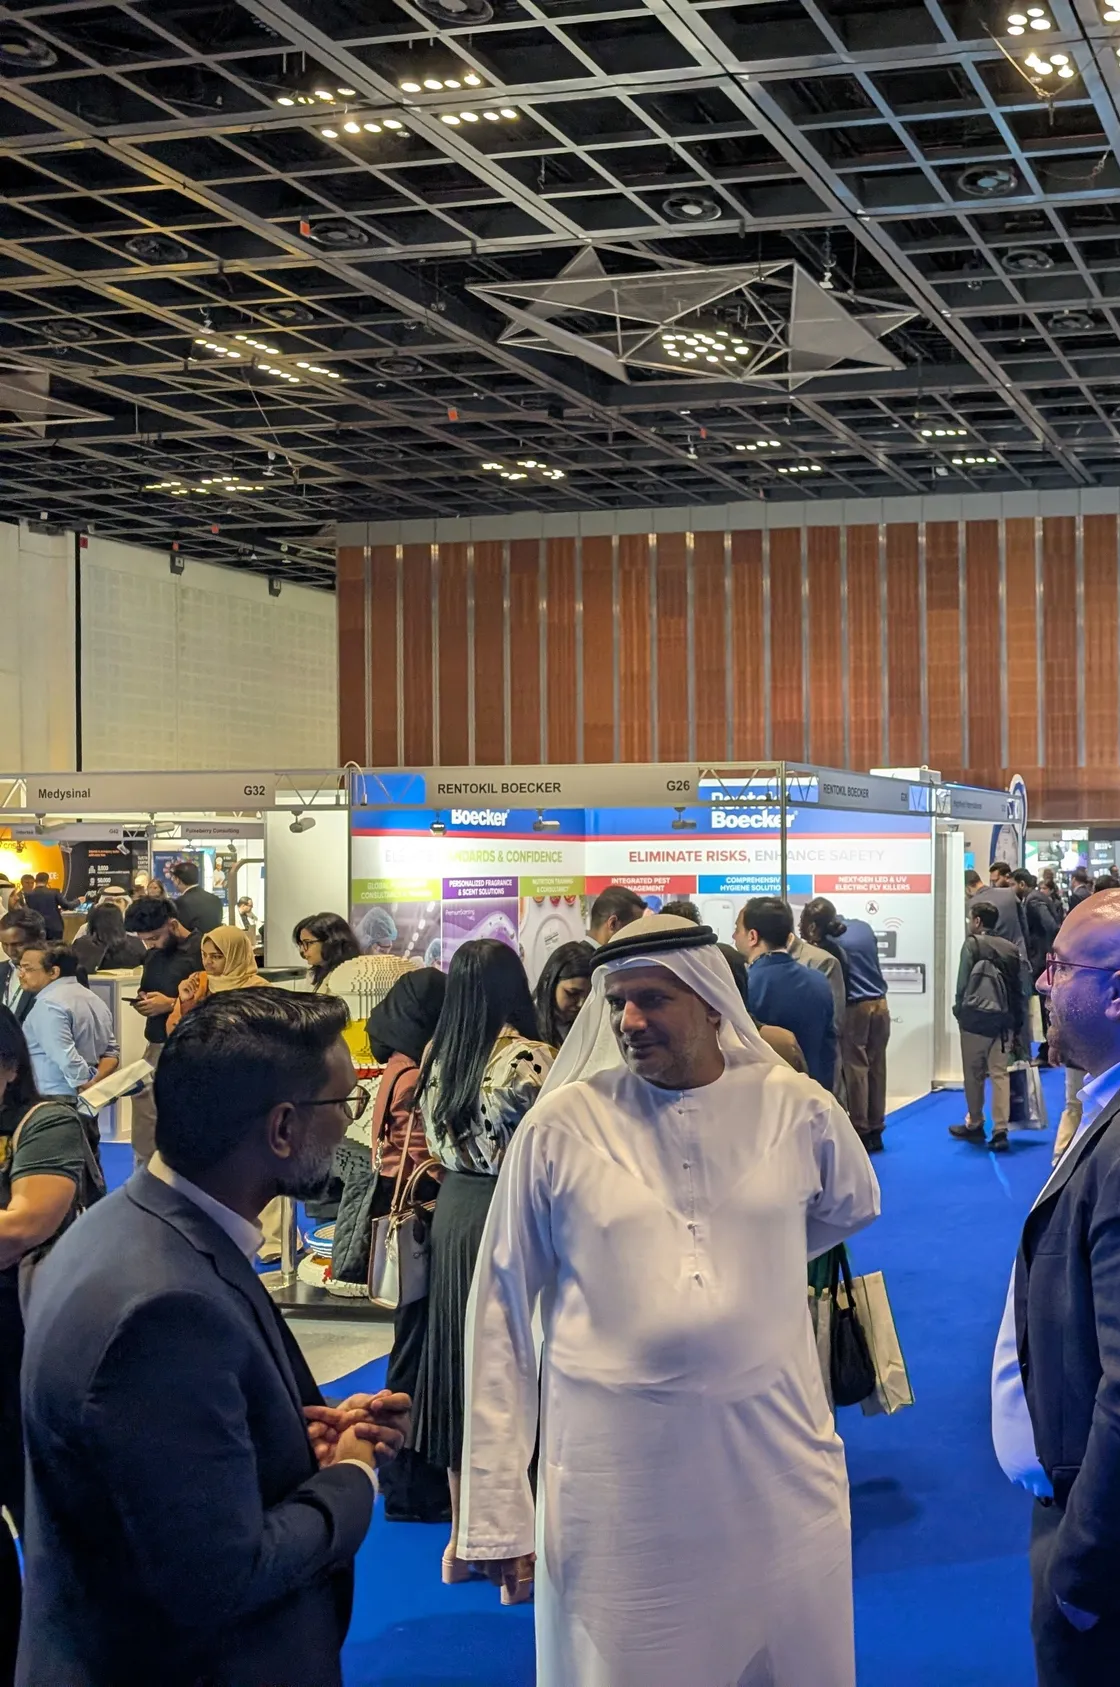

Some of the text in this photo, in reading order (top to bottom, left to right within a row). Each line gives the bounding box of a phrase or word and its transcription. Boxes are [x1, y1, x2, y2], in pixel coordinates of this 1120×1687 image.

[243, 785, 266, 796] G32
[437, 781, 561, 795] RENTOKIL BOECKER
[666, 780, 691, 792] G26
[823, 783, 869, 799] RENTOKIL BOECKER
[38, 787, 91, 801] Medysinal
[451, 809, 508, 827] Boecker
[711, 809, 795, 829] Boecker
[506, 850, 563, 863] CONFIDENCE
[629, 849, 885, 864] ELIMINATE RISKS, ENHANCE SAFETY
[611, 877, 653, 885] INTEGRATED
[725, 876, 782, 884] COMPREHENSIV
[625, 884, 665, 892] NAGEMENT
[720, 884, 750, 892] HYGIENE
[882, 883, 911, 891] KILLERS
